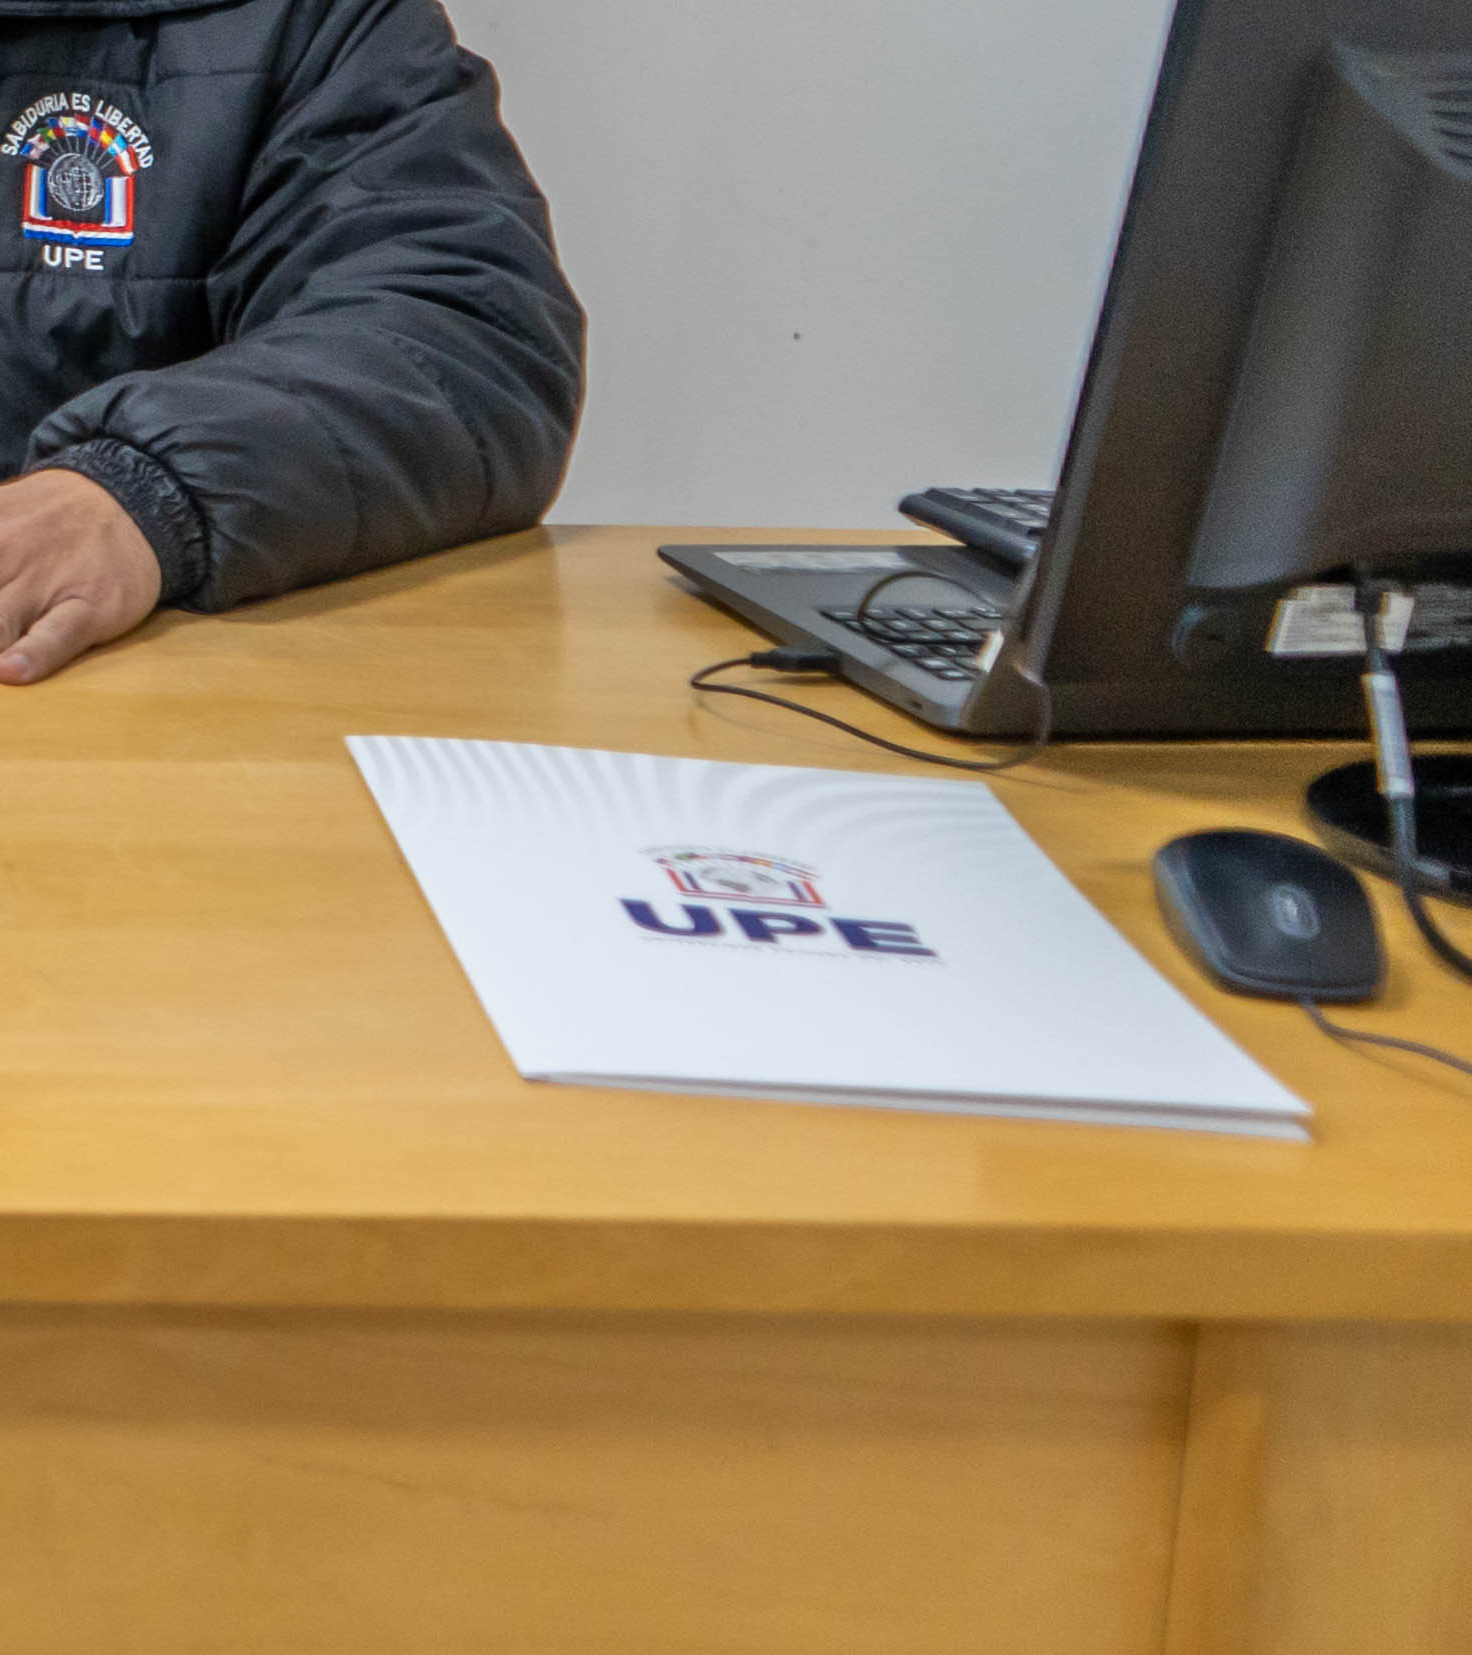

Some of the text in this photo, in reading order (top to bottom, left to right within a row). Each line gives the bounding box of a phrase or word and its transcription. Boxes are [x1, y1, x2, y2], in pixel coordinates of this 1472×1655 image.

[0, 92, 154, 169] SABIDURIA ES LIBERTAD
[42, 244, 105, 270] UPE
[618, 897, 939, 957] UPE
